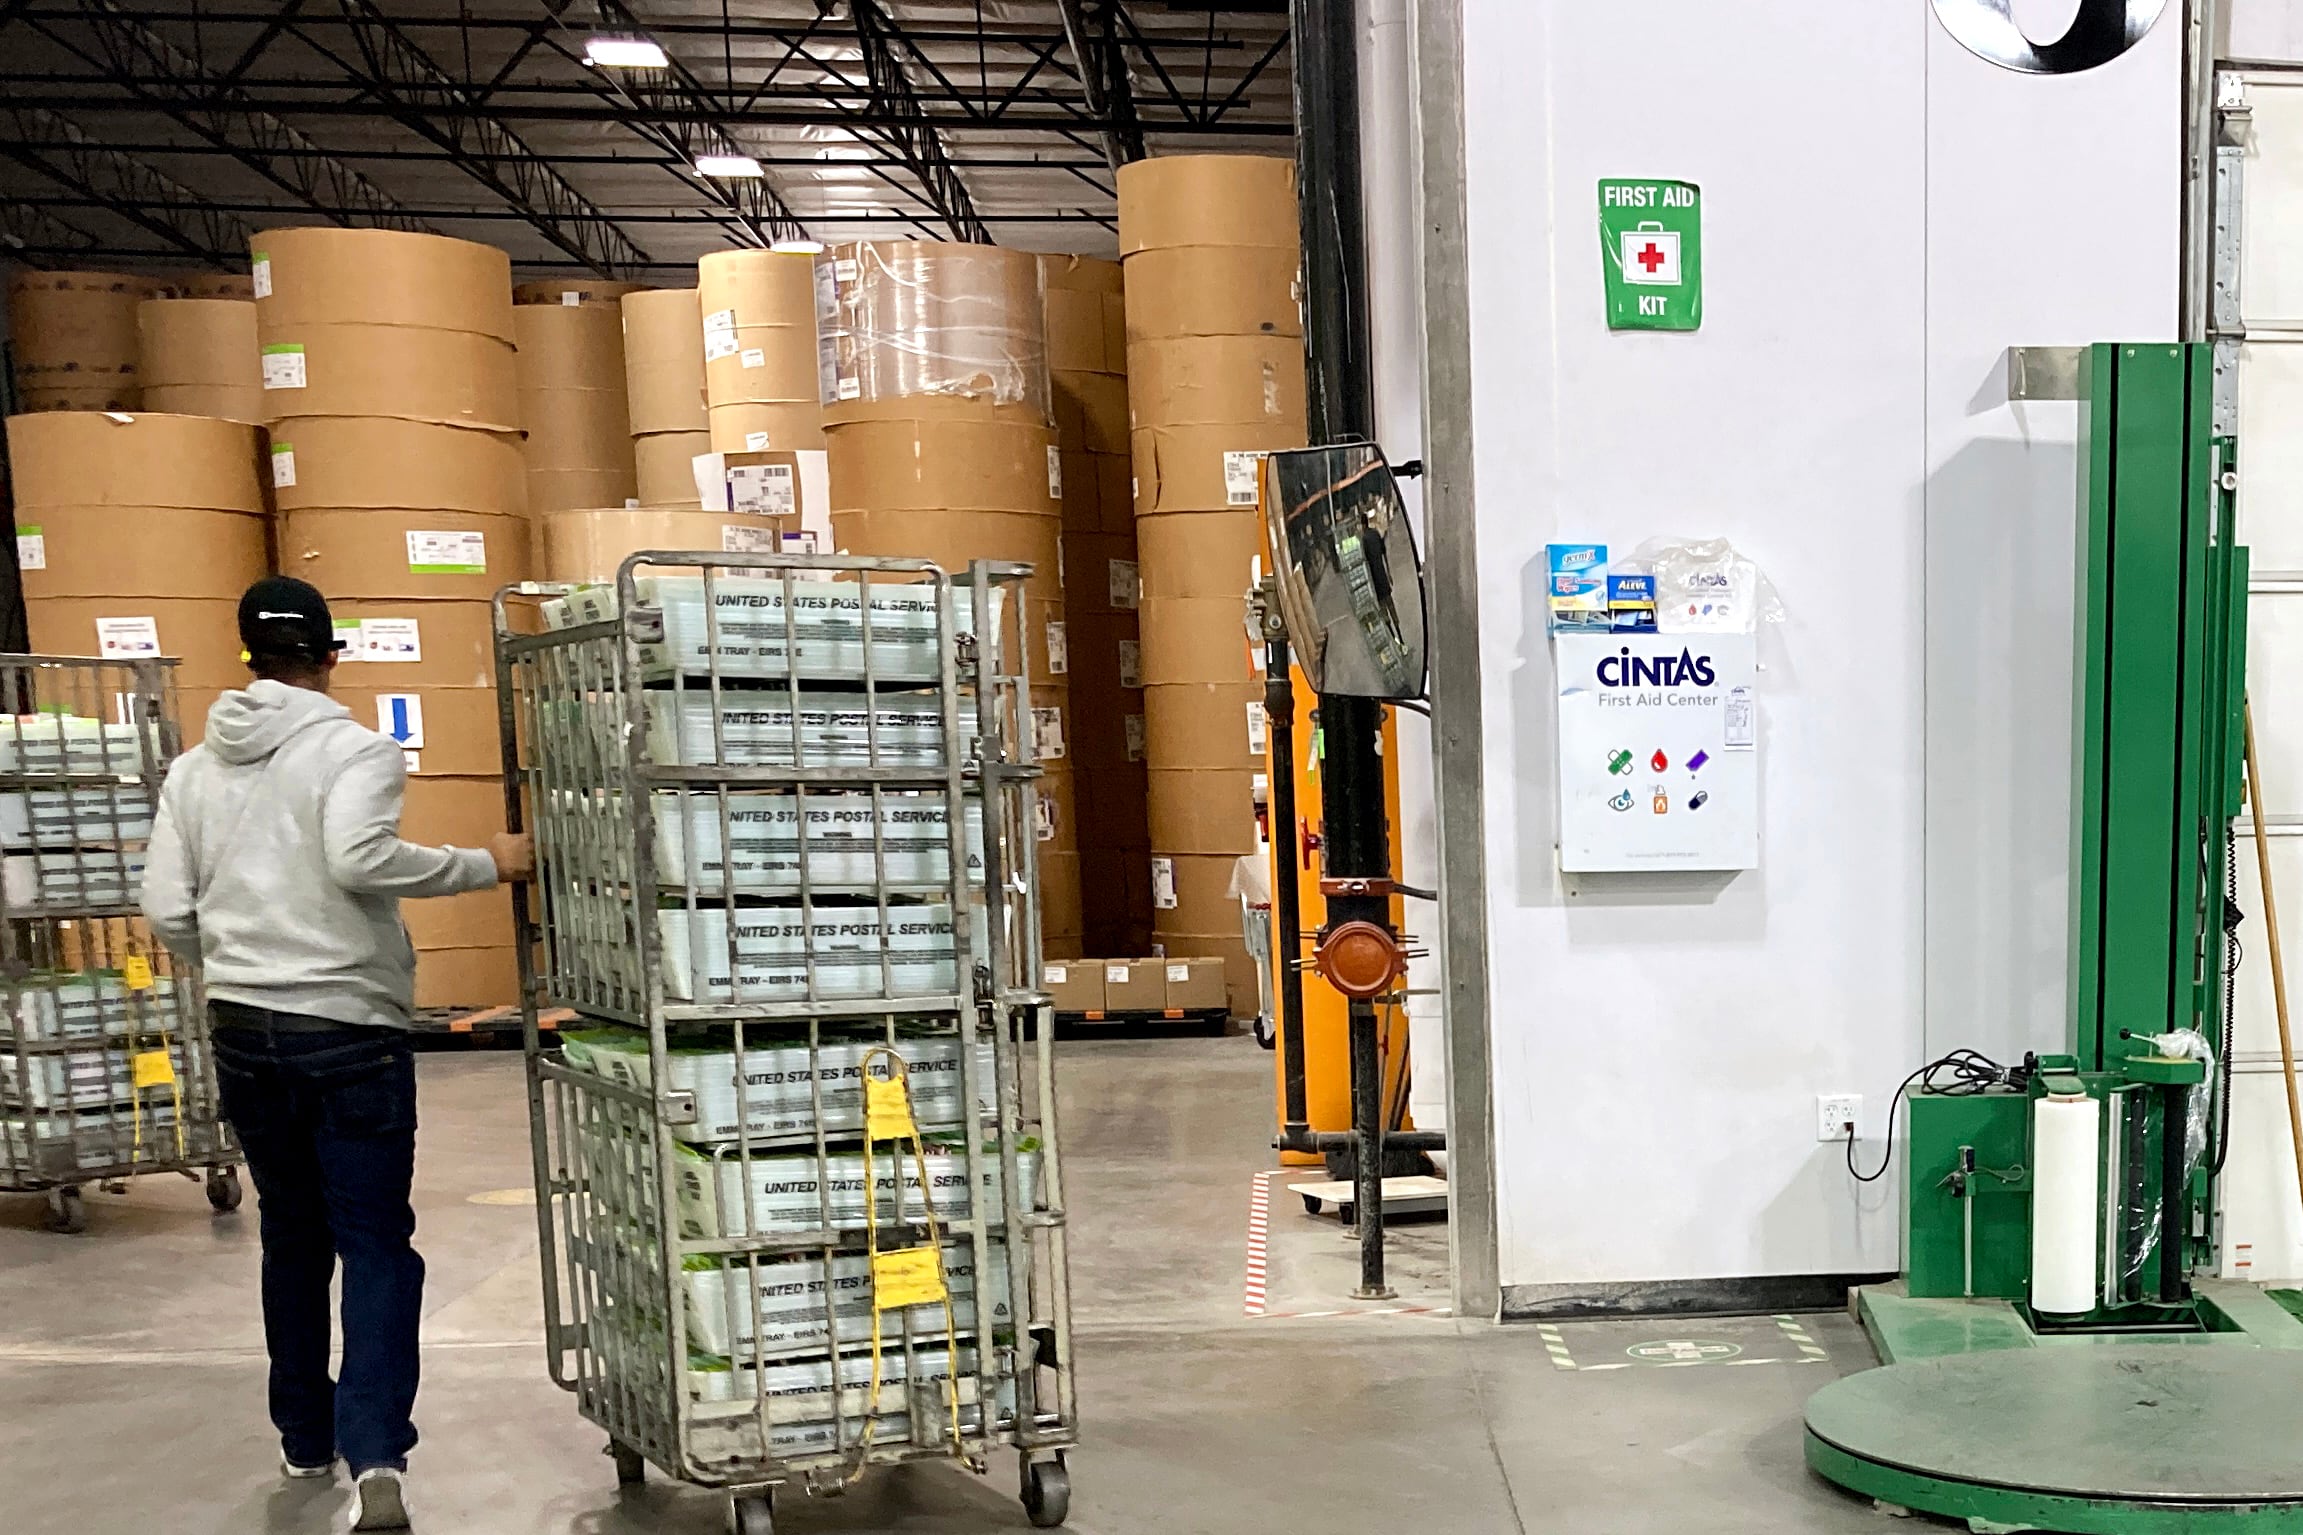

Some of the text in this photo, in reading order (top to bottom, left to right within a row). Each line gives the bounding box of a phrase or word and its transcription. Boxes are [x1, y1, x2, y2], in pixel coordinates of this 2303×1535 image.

[1604, 186, 1695, 207] FIRST AID
[1638, 295, 1668, 316] KIT
[716, 595, 769, 608] UNITED
[773, 596, 827, 609] SATES
[830, 598, 887, 611] POSAL
[1599, 693, 1719, 707] First Aid Center
[730, 811, 773, 822] NITED
[737, 926, 780, 938] NITED
[840, 924, 895, 936] POSTL
[740, 976, 761, 985] RAY
[787, 1068, 839, 1083] STAES
[905, 1059, 958, 1073] ERVICE
[765, 1181, 817, 1194] UNITED
[759, 1282, 804, 1298] NITED
